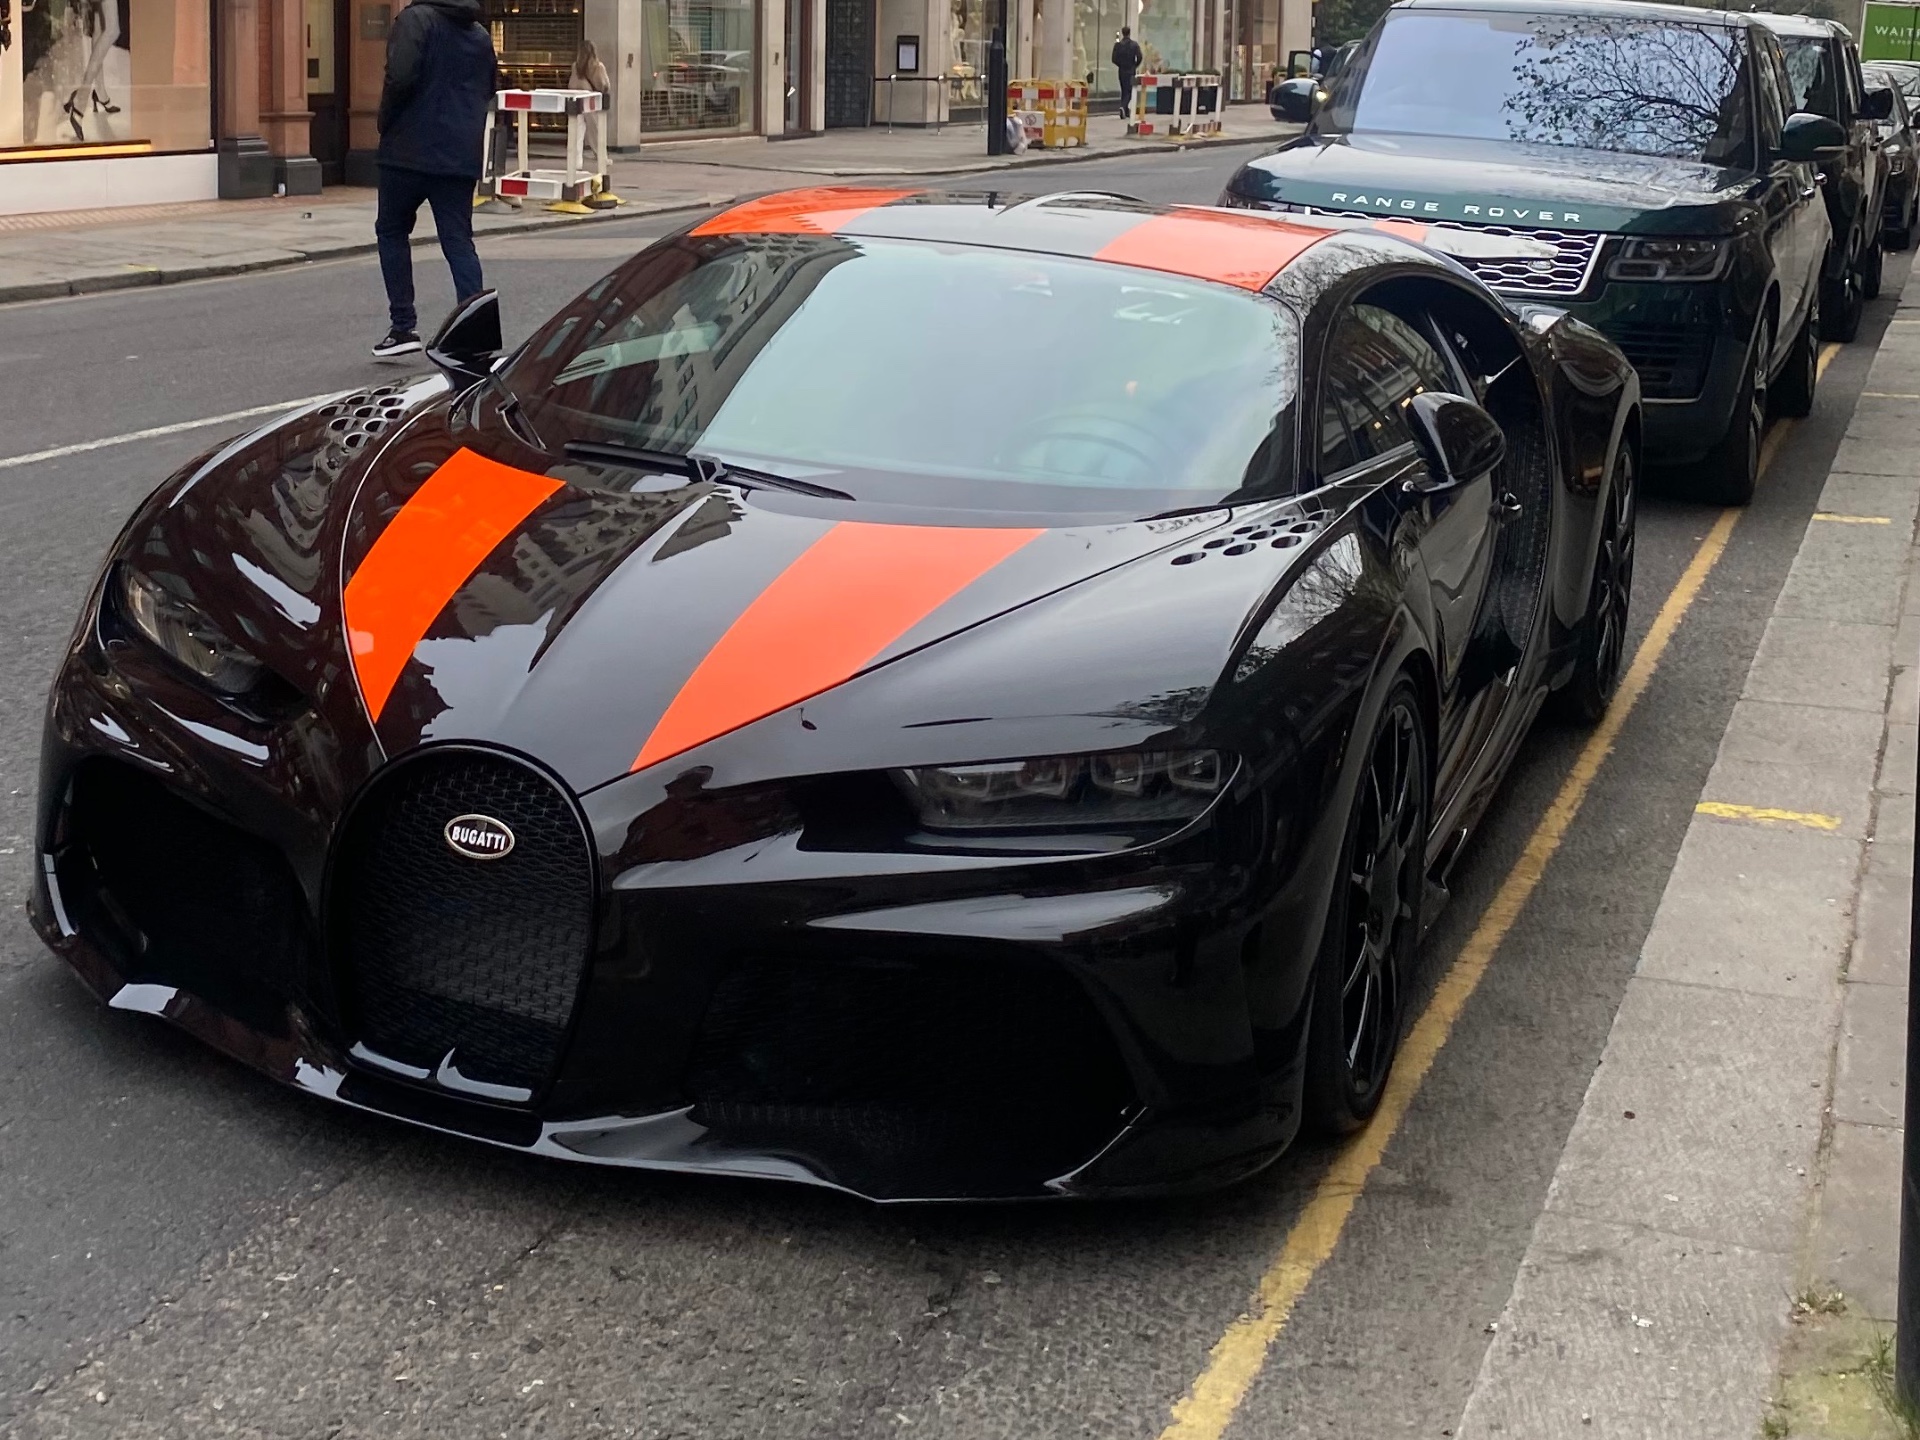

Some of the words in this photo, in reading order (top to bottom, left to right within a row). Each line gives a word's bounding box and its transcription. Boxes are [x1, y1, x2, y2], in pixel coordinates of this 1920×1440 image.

[1332, 193, 1440, 211] RANGE
[1463, 205, 1580, 222] ROVER
[452, 826, 506, 850] BUGATTI
